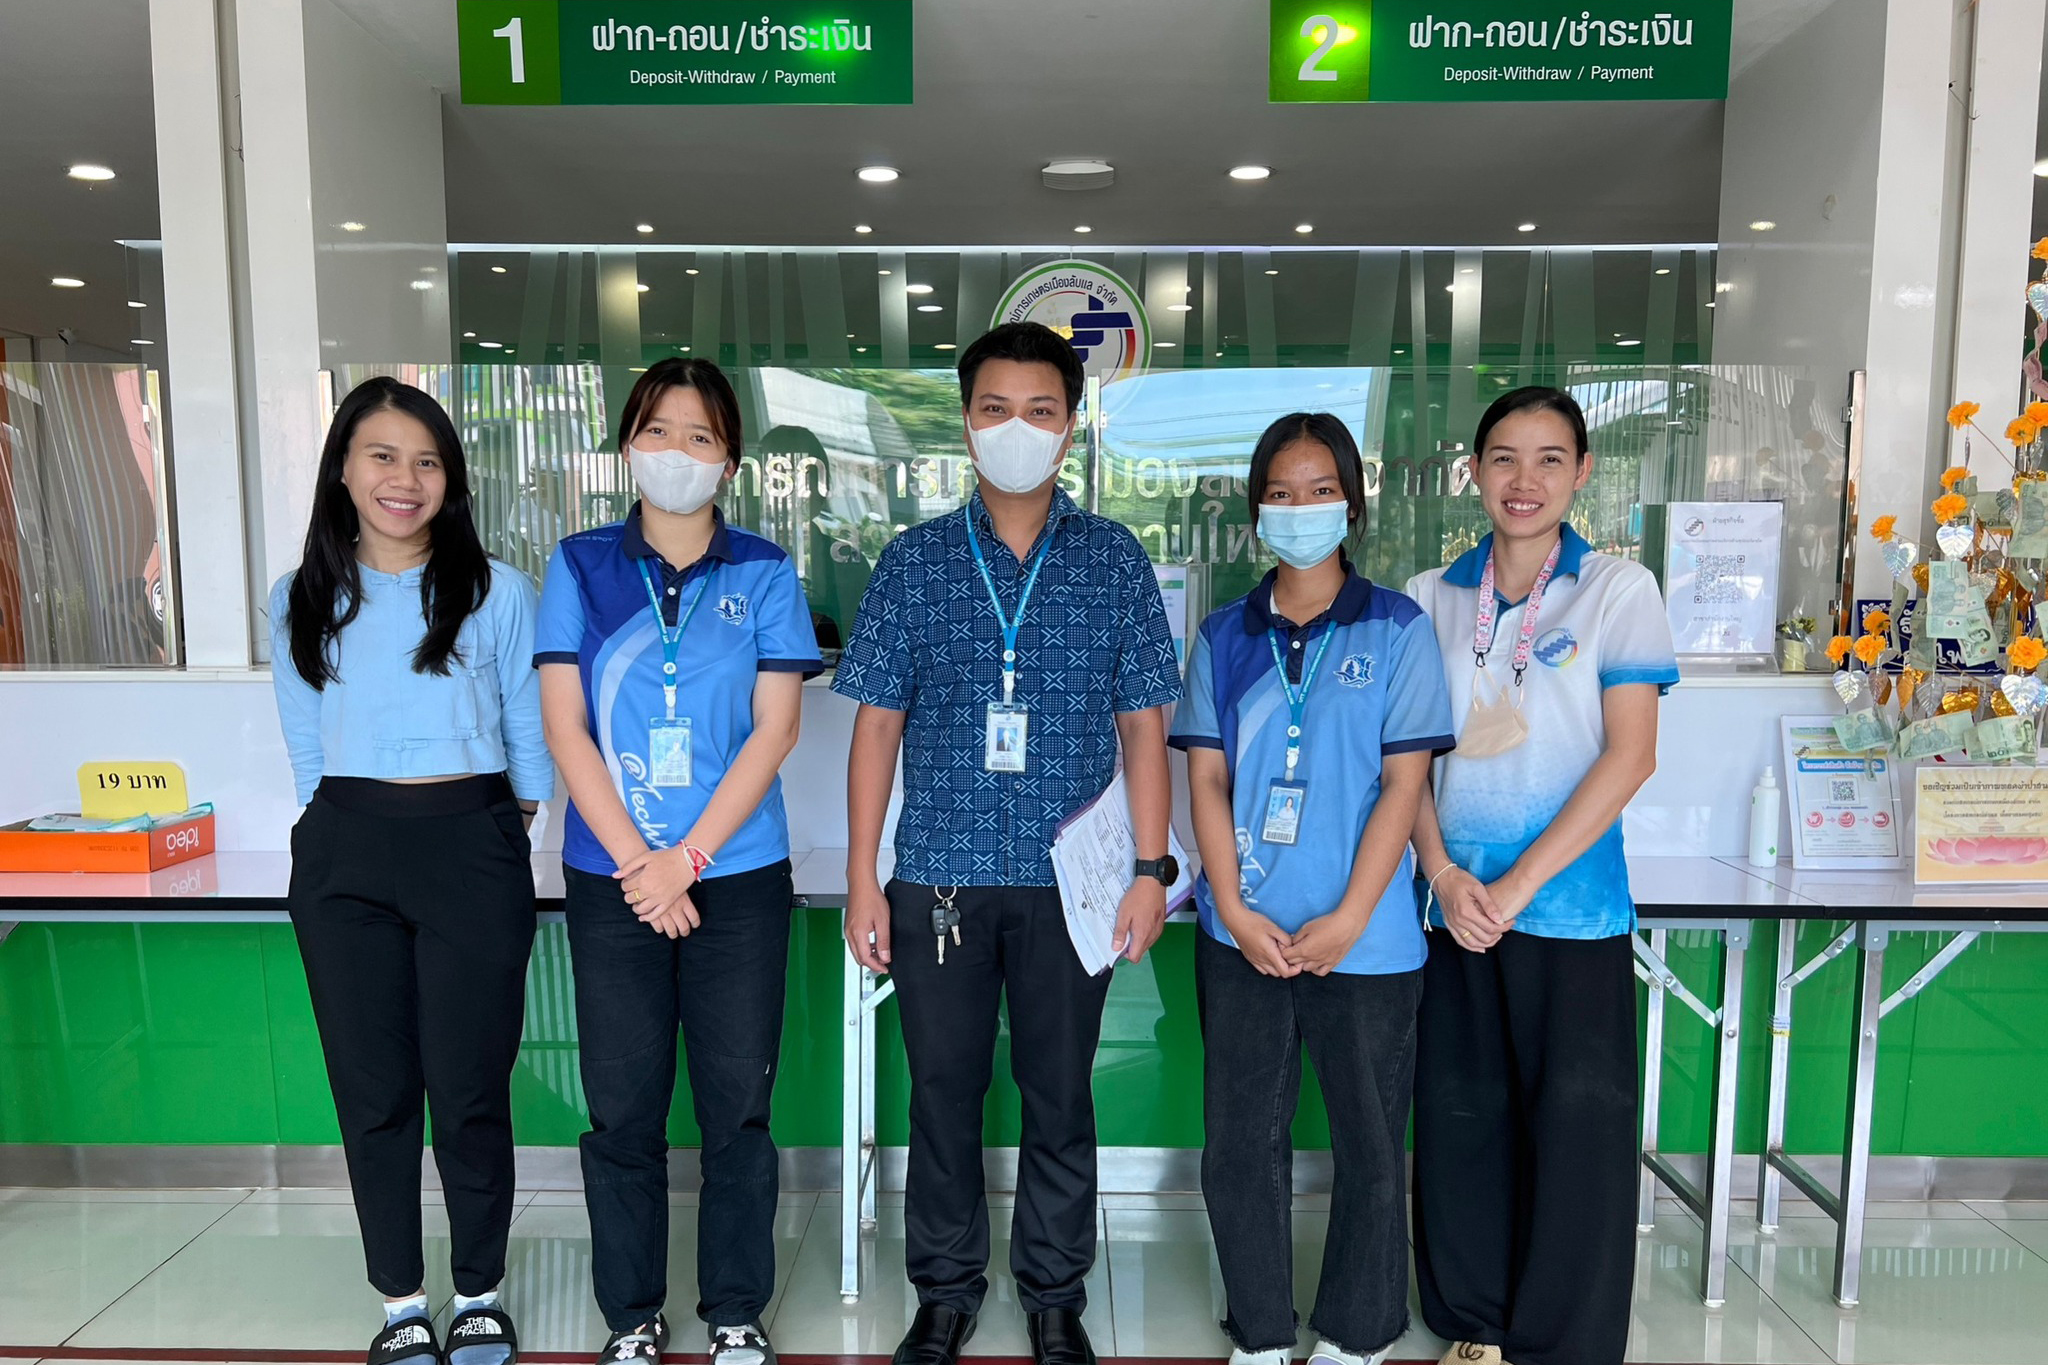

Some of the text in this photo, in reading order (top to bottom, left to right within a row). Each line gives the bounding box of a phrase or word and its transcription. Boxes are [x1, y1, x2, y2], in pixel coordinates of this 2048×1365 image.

[493, 17, 525, 83] 1
[1297, 14, 1339, 81] 2
[630, 70, 755, 86] Deposit-Withdraw
[775, 70, 836, 87] Payment
[1444, 66, 1571, 83] Deposit-Withdraw
[1591, 66, 1653, 83] Payment
[97, 773, 167, 789] 19 บาท
[166, 826, 199, 852] idea
[453, 1322, 485, 1336] NORTH
[466, 1317, 485, 1325] THE
[394, 1325, 413, 1337] THE
[462, 1328, 486, 1337] FACE
[381, 1332, 413, 1350] NORTH
[389, 1339, 414, 1352] FACE
